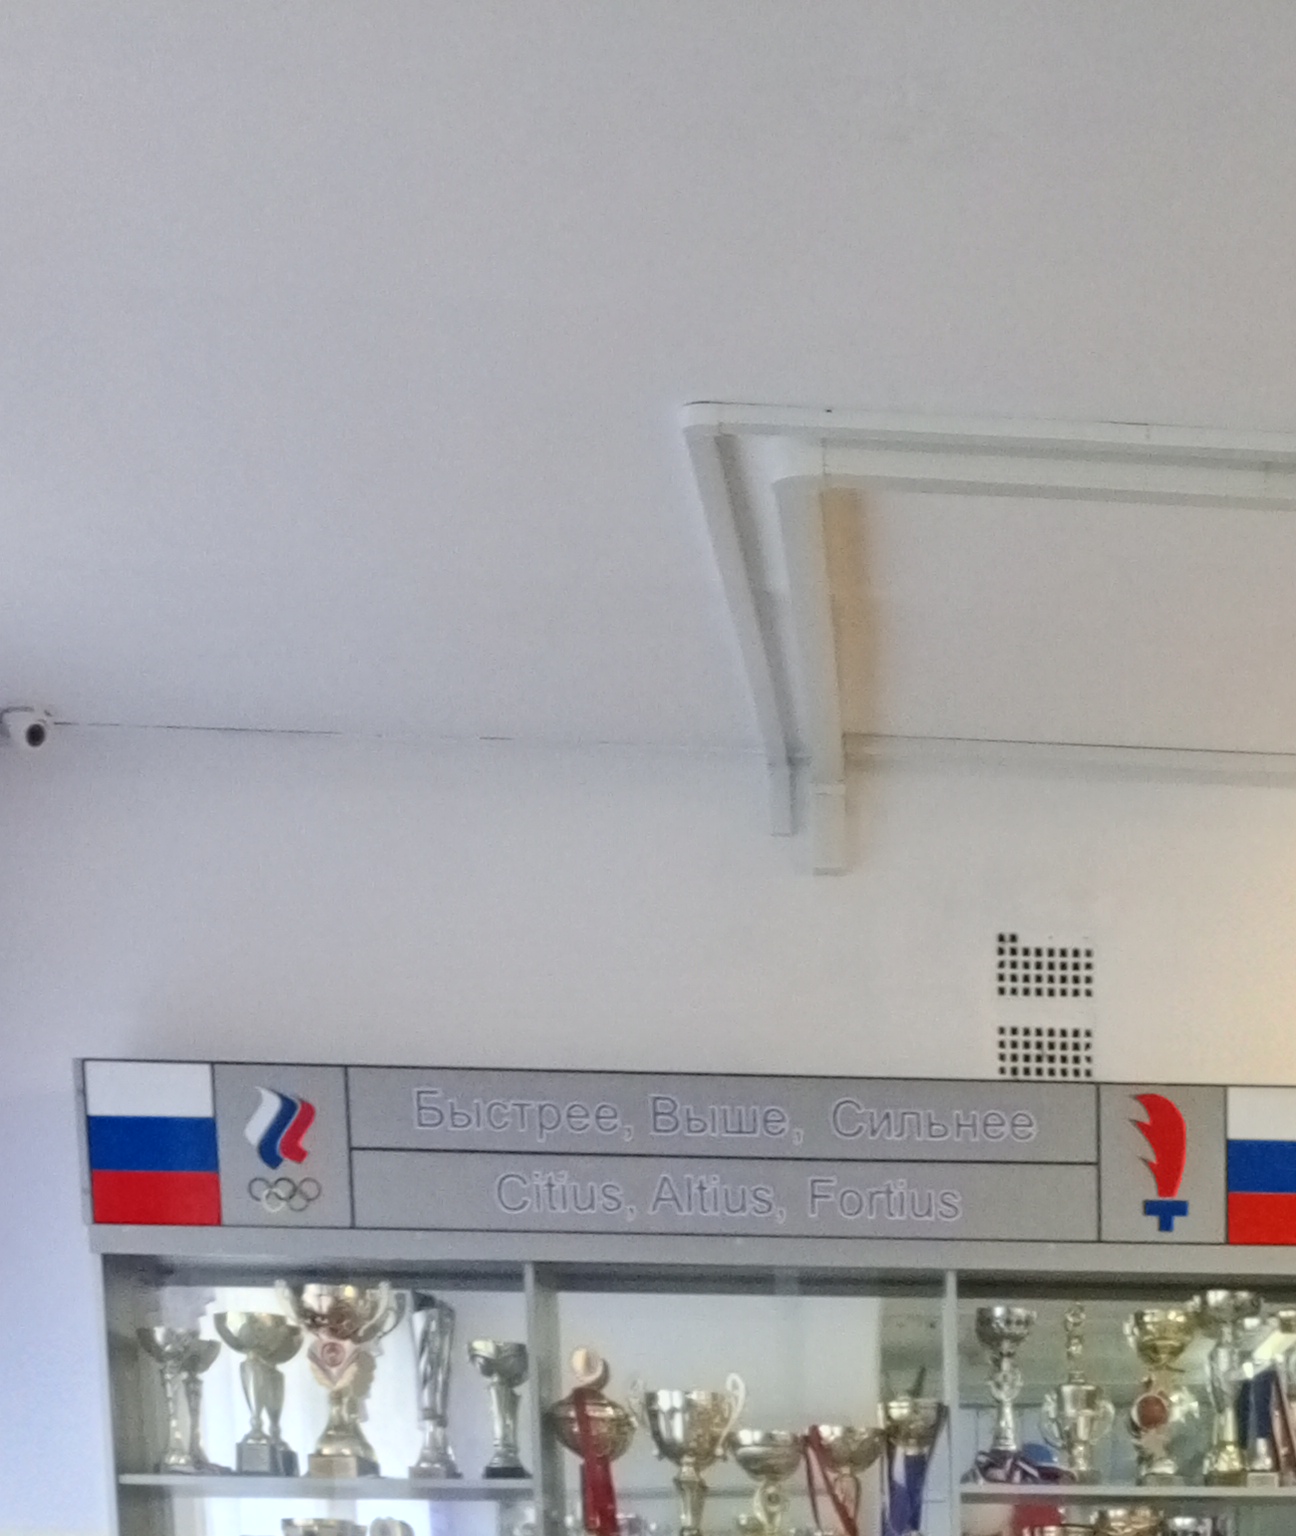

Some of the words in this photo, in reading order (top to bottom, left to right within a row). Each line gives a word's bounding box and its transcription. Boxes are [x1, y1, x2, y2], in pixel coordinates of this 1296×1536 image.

[413, 1088, 634, 1142] Быстрее,
[648, 1093, 803, 1146] Выше,
[832, 1098, 1037, 1143] Сильнее
[496, 1170, 636, 1222] Citius,
[648, 1173, 786, 1224] Altius,
[807, 1176, 963, 1222] Fortius
